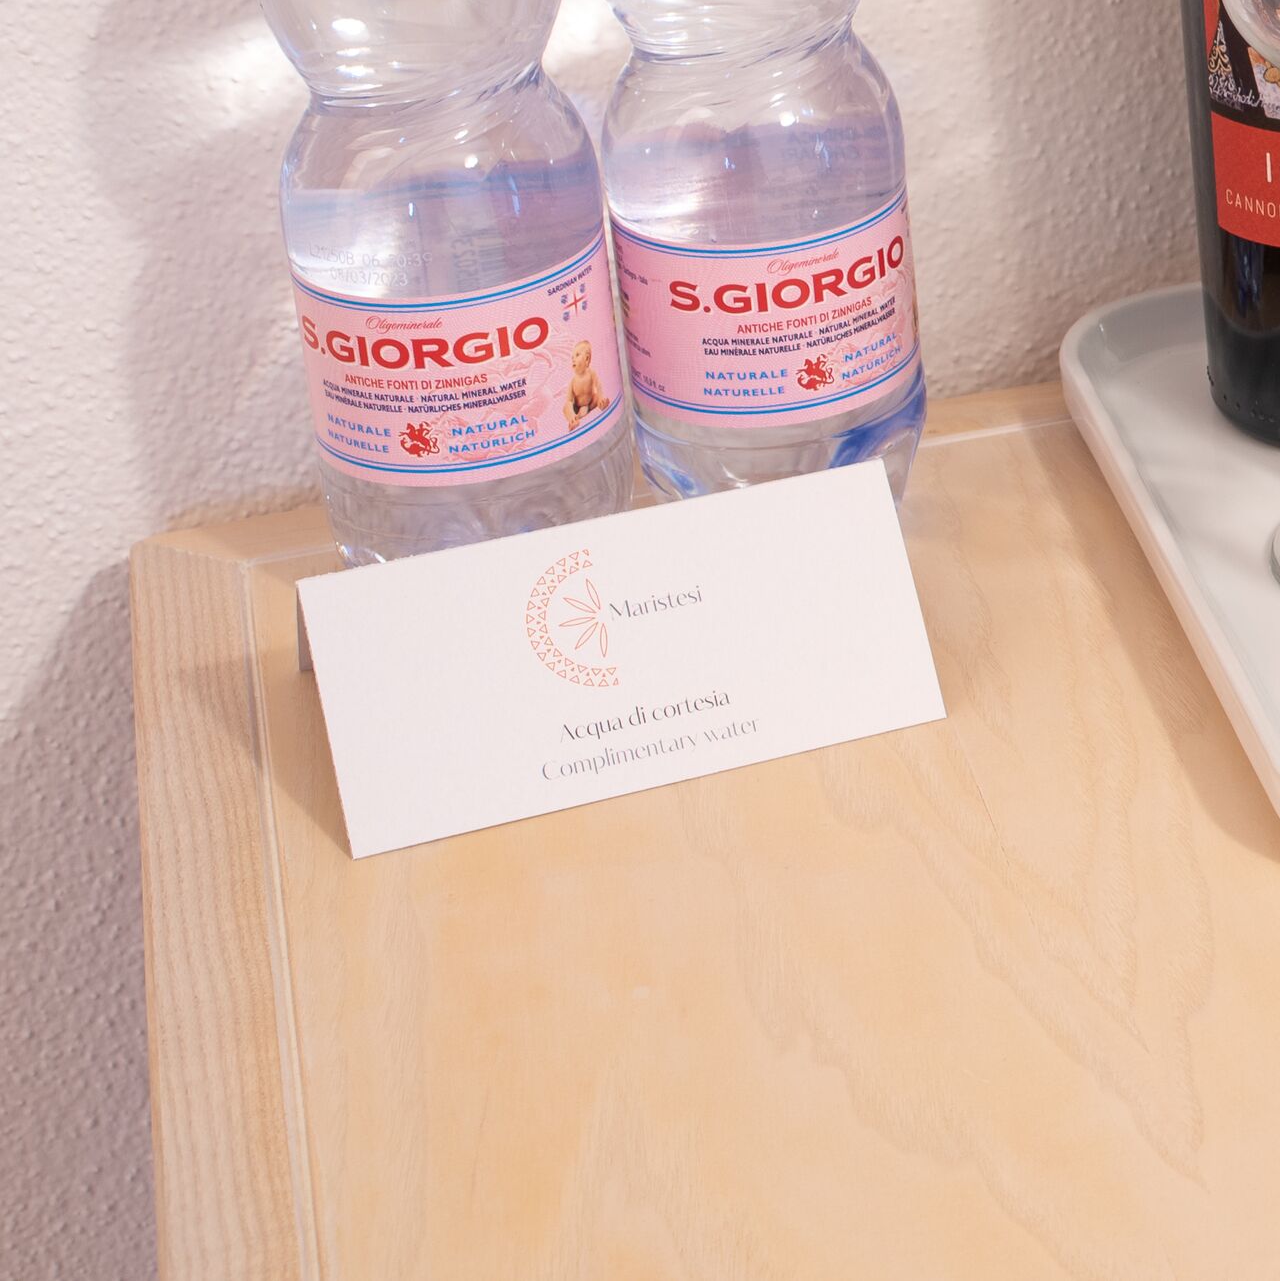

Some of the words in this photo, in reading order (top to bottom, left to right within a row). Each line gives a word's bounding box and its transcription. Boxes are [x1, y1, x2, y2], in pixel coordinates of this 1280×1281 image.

[669, 235, 905, 313] S.GIORGIO
[767, 246, 840, 276] Oligominerale
[547, 276, 577, 296] SARDINIAN
[577, 265, 593, 283] WATER
[365, 315, 443, 334] Oligominerale
[702, 336, 730, 347] ACQUA
[731, 336, 770, 346] MINERALE
[772, 330, 813, 344] NATURALE
[818, 319, 851, 336] NATURAL
[852, 308, 879, 324] MINERAL
[704, 346, 719, 356] EAU
[758, 343, 801, 356] NATURELLE
[853, 306, 896, 335] MINERALWASSER
[737, 316, 784, 335] ANTICHE
[786, 315, 817, 330] FONTI
[820, 311, 829, 323] DI
[831, 296, 872, 320] ZINNIGAS
[302, 315, 549, 369] S.GIORGIO
[705, 368, 789, 381] NATURALE
[844, 333, 898, 363] NATURAL
[323, 378, 341, 394] ACQUA
[341, 386, 372, 401] MINERALE
[374, 393, 415, 404] NATURALE
[420, 391, 459, 404] NATURAL
[461, 386, 499, 400] MINERAL
[499, 378, 527, 392] WATER
[345, 373, 385, 390] ANTICHE
[387, 379, 418, 391] FONTI
[421, 380, 432, 391] DI
[435, 373, 488, 390] ZINNIGAS
[703, 385, 786, 398] NATURELLE
[324, 389, 336, 401] EAU
[363, 401, 403, 413] NATURELLE
[463, 389, 527, 410] MINERALWASSER
[328, 413, 392, 437] NATURALE
[451, 414, 529, 437] NATURAL
[328, 429, 390, 454] NATURELLE
[608, 584, 703, 622] Maristesi
[559, 716, 624, 743] Acqua
[628, 705, 647, 727] di
[652, 690, 731, 722] cortesia
[541, 731, 699, 782] Complimentary
[702, 717, 760, 743] water
